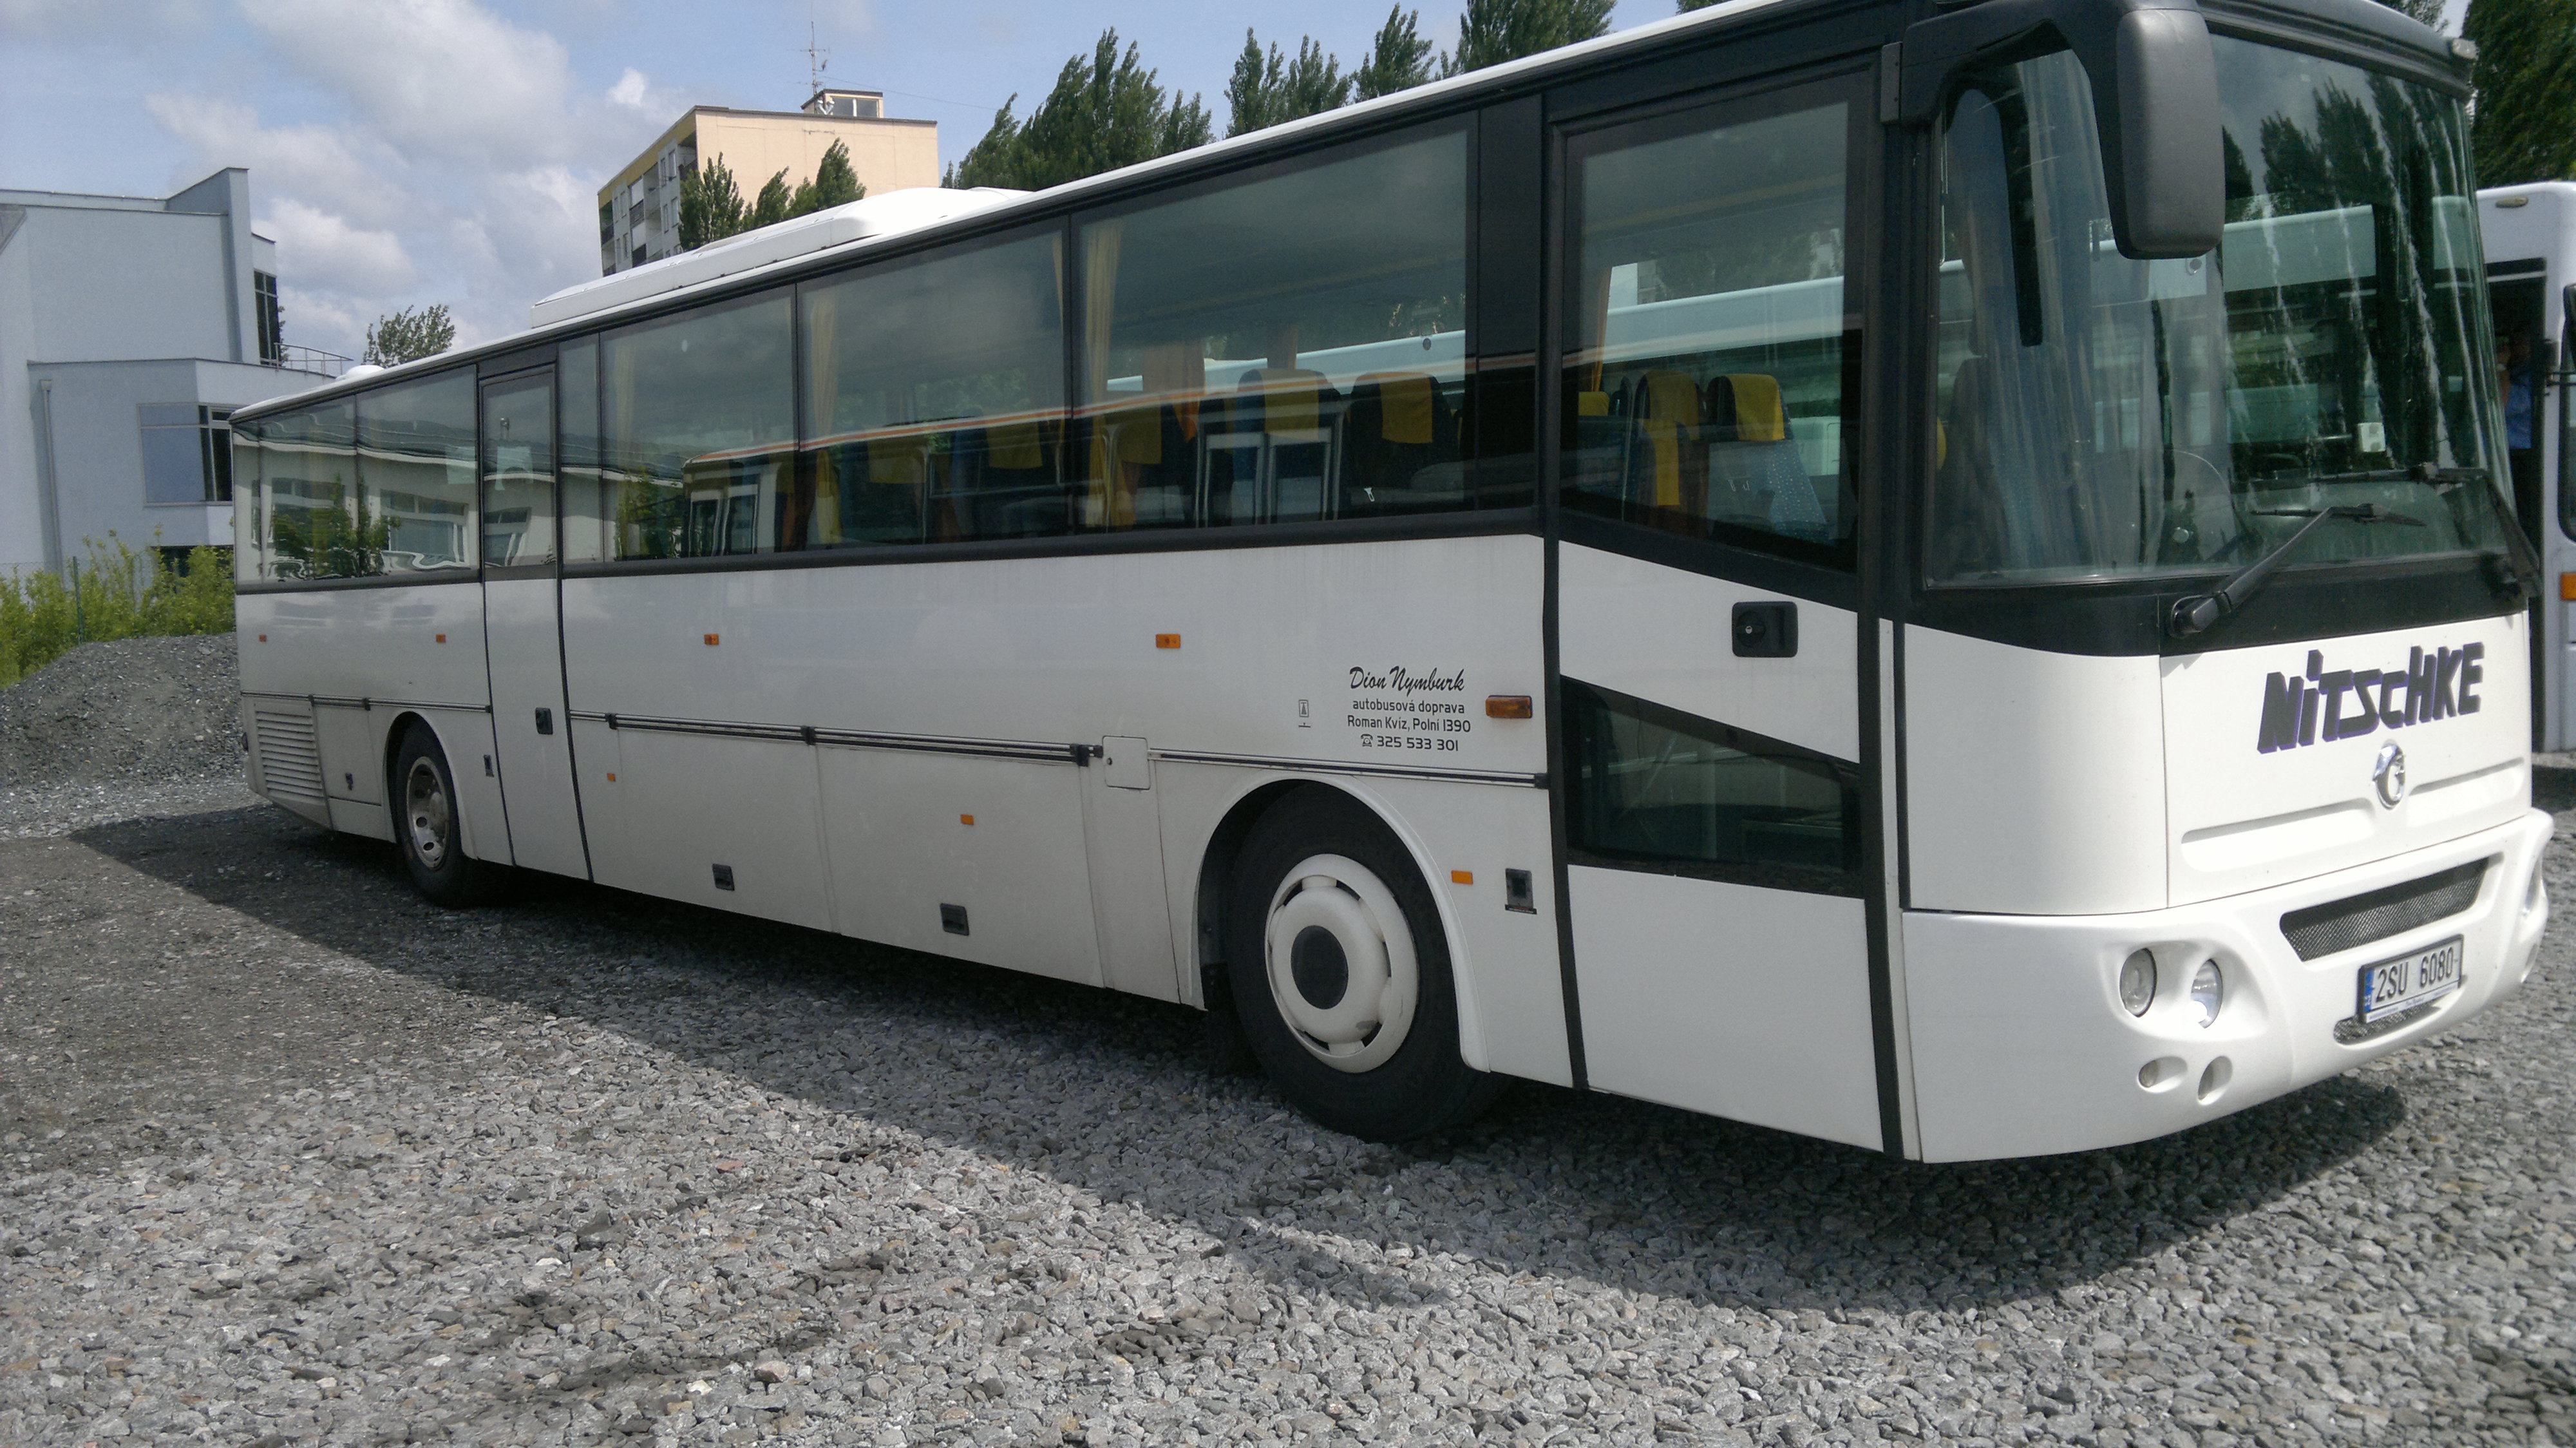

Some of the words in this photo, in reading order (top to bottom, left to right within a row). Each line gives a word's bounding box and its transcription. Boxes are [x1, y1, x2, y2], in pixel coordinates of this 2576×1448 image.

[1349, 666, 1387, 689] Dion
[1389, 665, 1464, 697] Nymburk
[1352, 698, 1416, 712] autobusová
[1418, 700, 1464, 715] doprava
[1347, 715, 1383, 729] Roman
[1385, 717, 1410, 732] Kvíz,
[1413, 718, 1440, 731] Polní
[1443, 719, 1471, 732] 1390
[1377, 736, 1402, 748] 325
[1406, 737, 1432, 750] 533
[1437, 739, 1459, 752] 301
[2376, 962, 2409, 1002] 2SU
[2420, 947, 2453, 988] 6080
